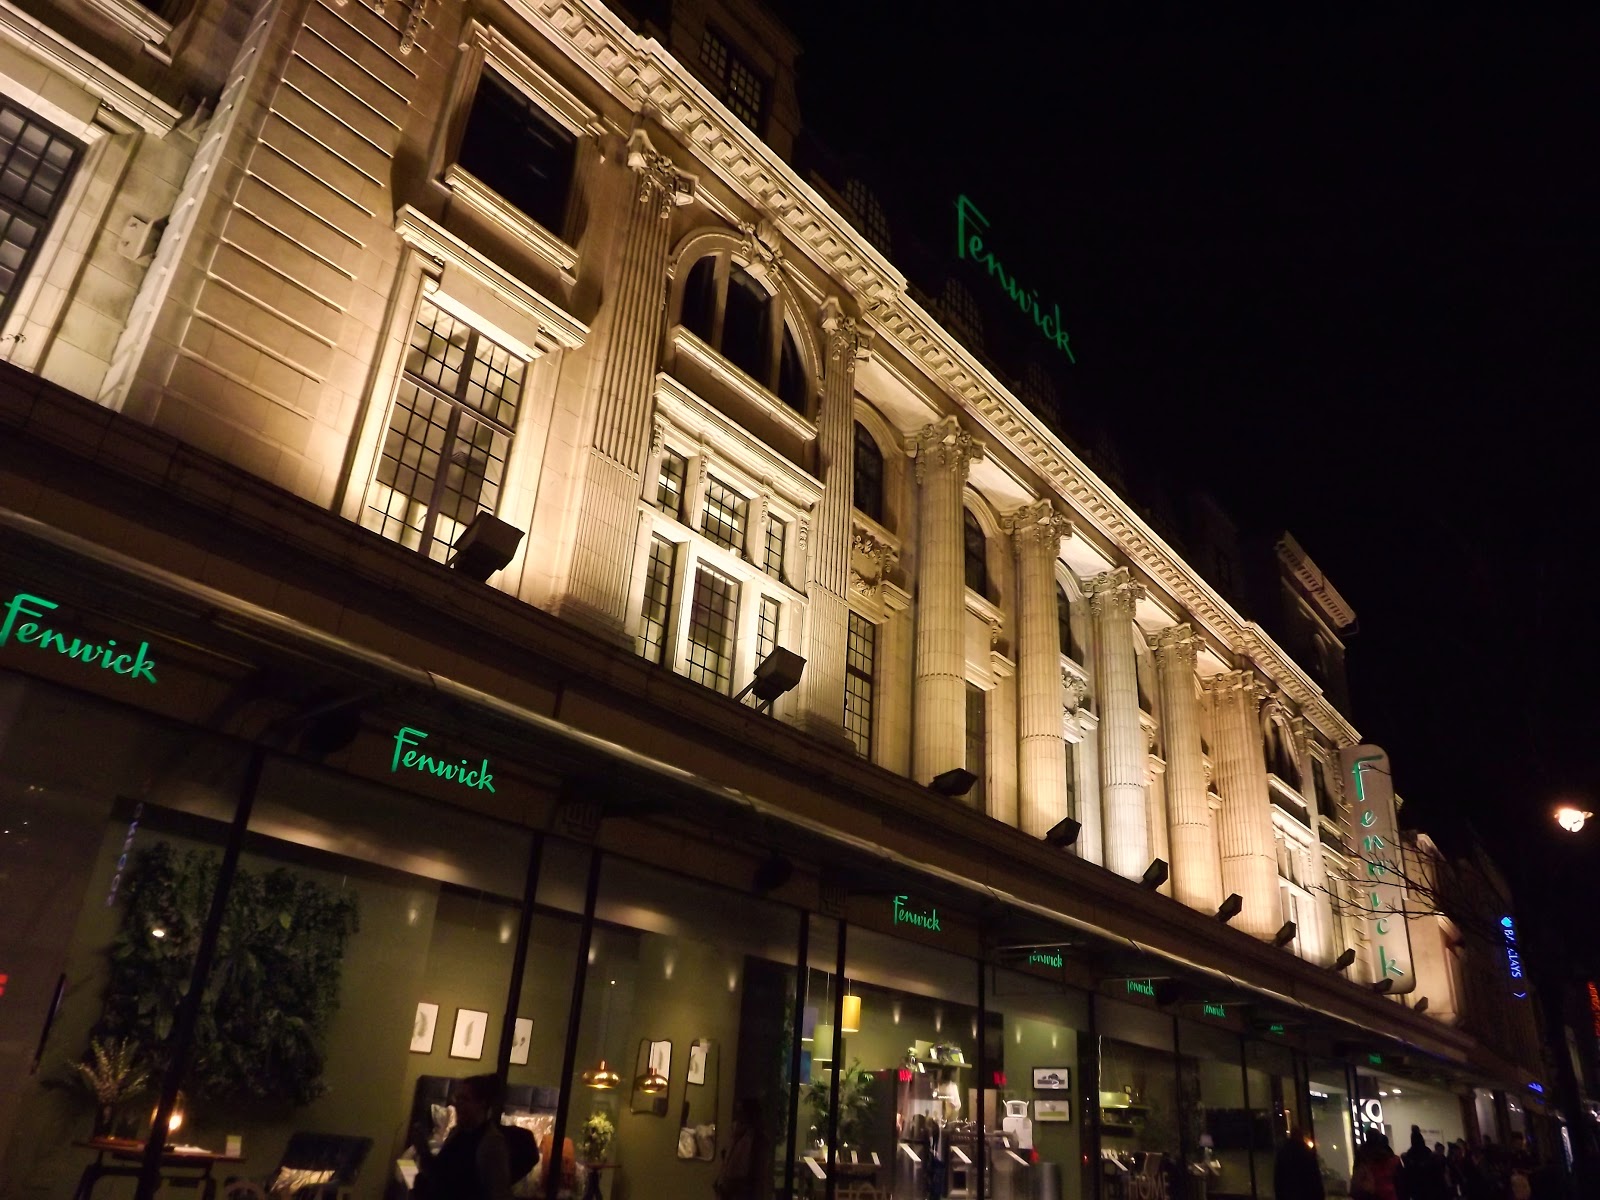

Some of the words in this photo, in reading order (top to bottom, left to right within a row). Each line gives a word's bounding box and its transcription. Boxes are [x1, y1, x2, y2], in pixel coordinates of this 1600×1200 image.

[953, 194, 1075, 364] Fenwick
[0, 593, 158, 685] Fenwick
[391, 726, 496, 793] Fenwick
[1352, 754, 1404, 978] Fenwick
[893, 895, 941, 931] Fenwick
[1503, 929, 1522, 978] BACLAYS
